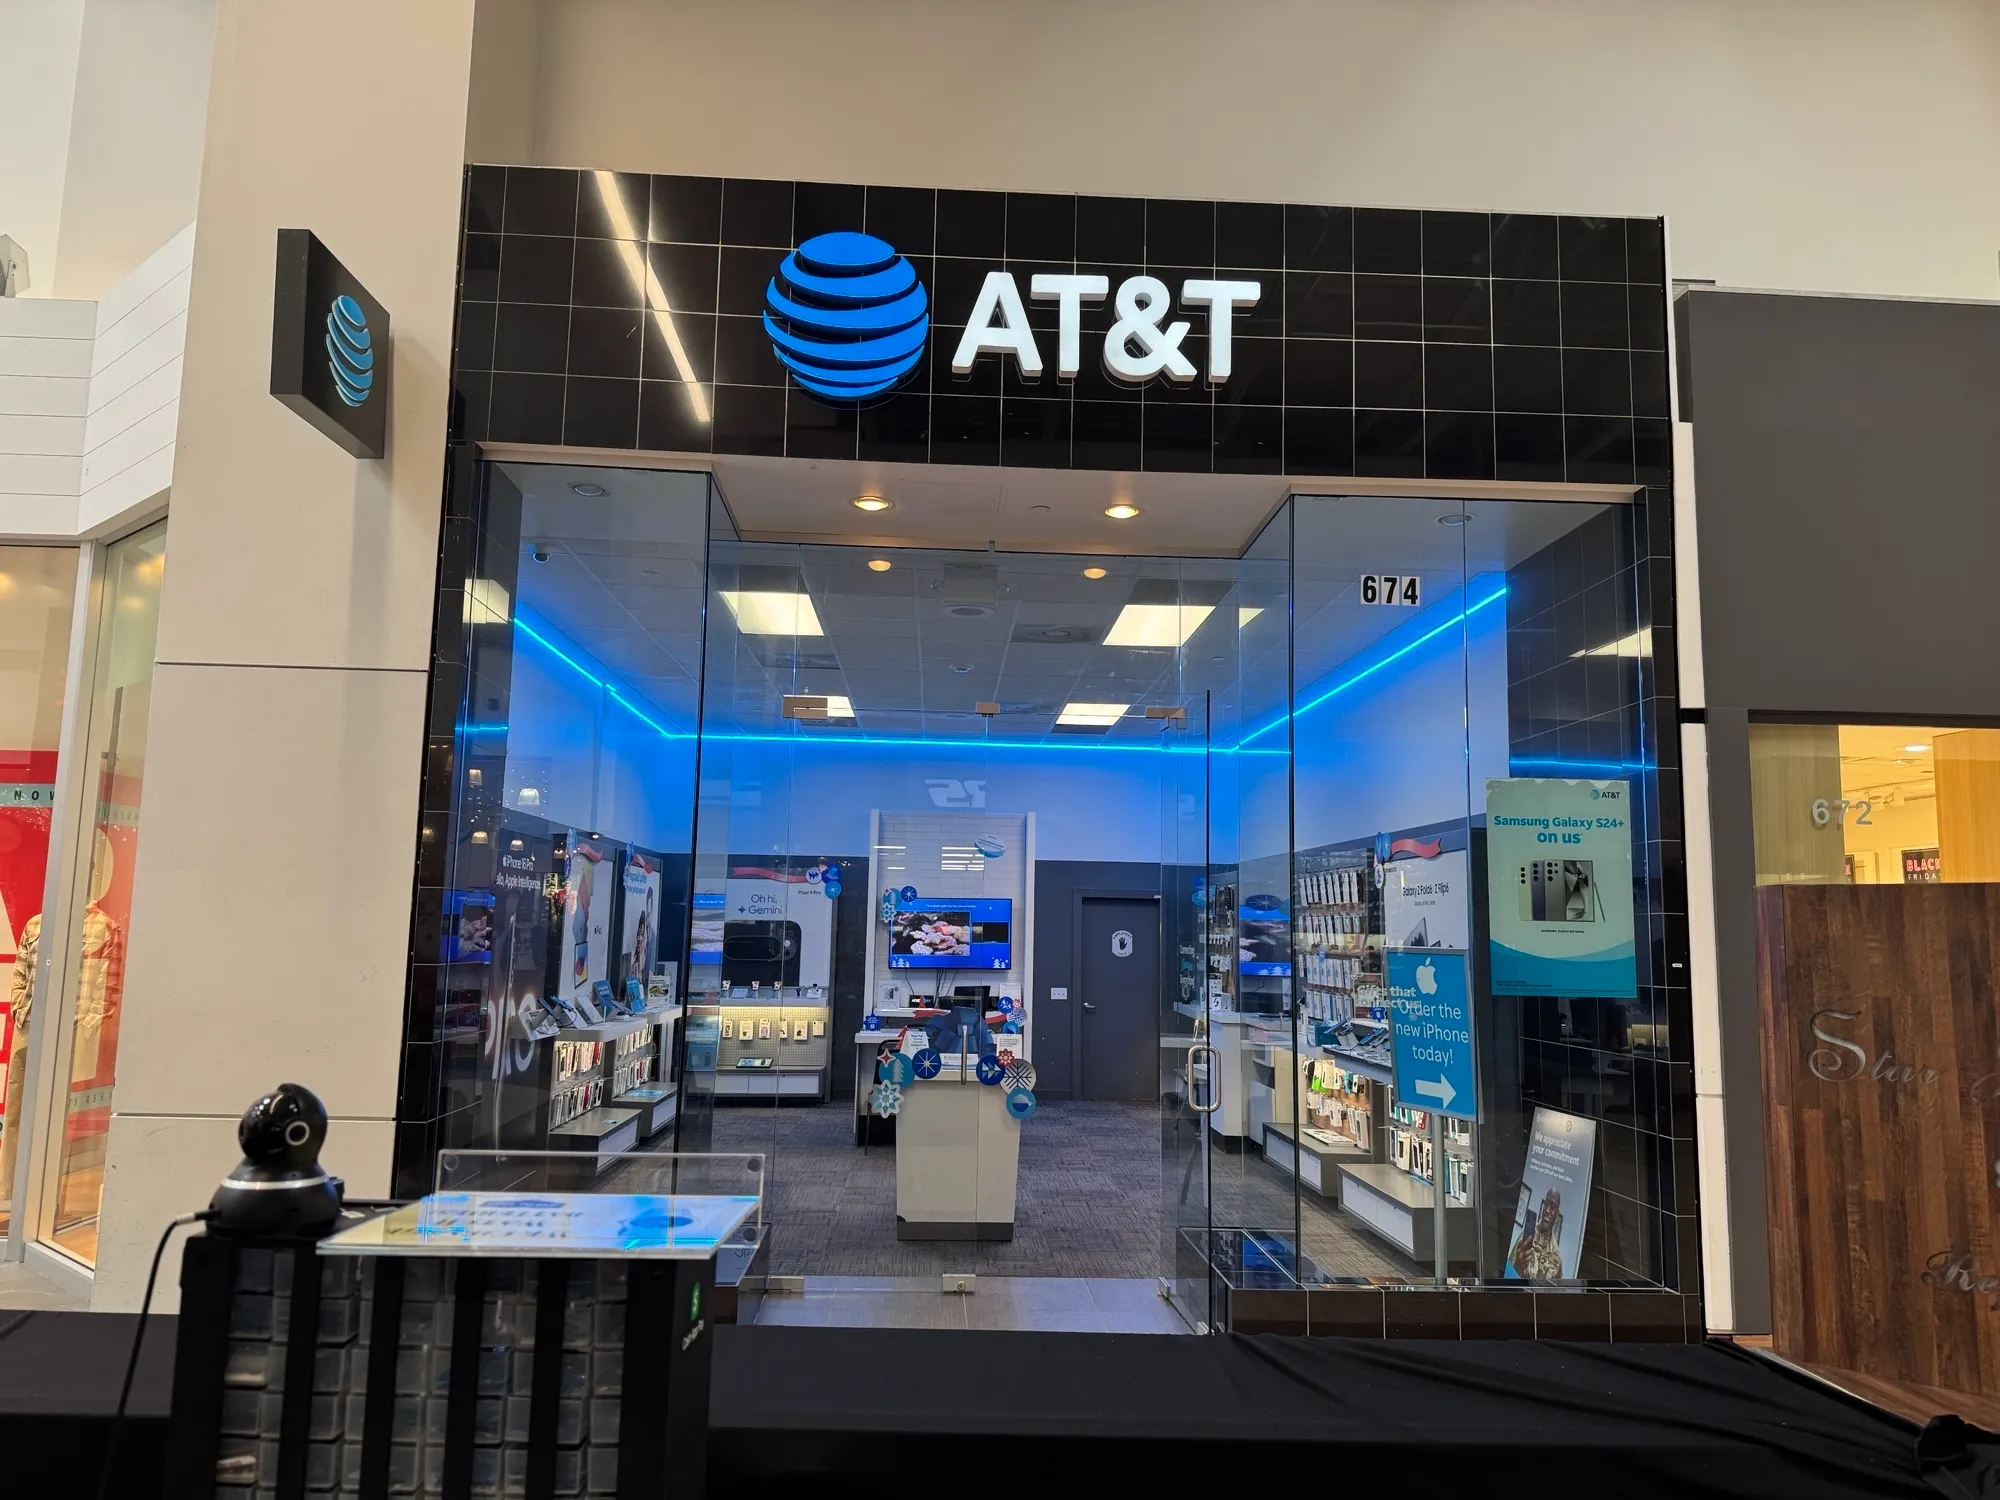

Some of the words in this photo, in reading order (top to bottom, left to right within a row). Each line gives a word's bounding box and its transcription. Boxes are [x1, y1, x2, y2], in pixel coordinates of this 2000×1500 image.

[952, 272, 1261, 382] AT&T
[1363, 575, 1418, 605] 674
[1601, 791, 1620, 799] AT&T
[1812, 799, 1872, 825] 672
[1494, 815, 1550, 829] Samsung
[1552, 816, 1593, 830] Galaxy
[1596, 818, 1624, 828] S24+
[1537, 832, 1558, 843] on
[750, 894, 766, 904] Oh
[768, 895, 778, 906] hi,
[748, 905, 783, 915] Gemini
[1390, 985, 1417, 997] that
[1400, 999, 1436, 1016] Order
[1438, 1002, 1461, 1019] the
[1395, 1023, 1420, 1037] new
[1423, 1021, 1469, 1043] iPhone
[1412, 1045, 1453, 1067] today!
[1543, 1135, 1572, 1150] appreciate
[1532, 1144, 1544, 1154] your
[1544, 1148, 1580, 1166] commitment
